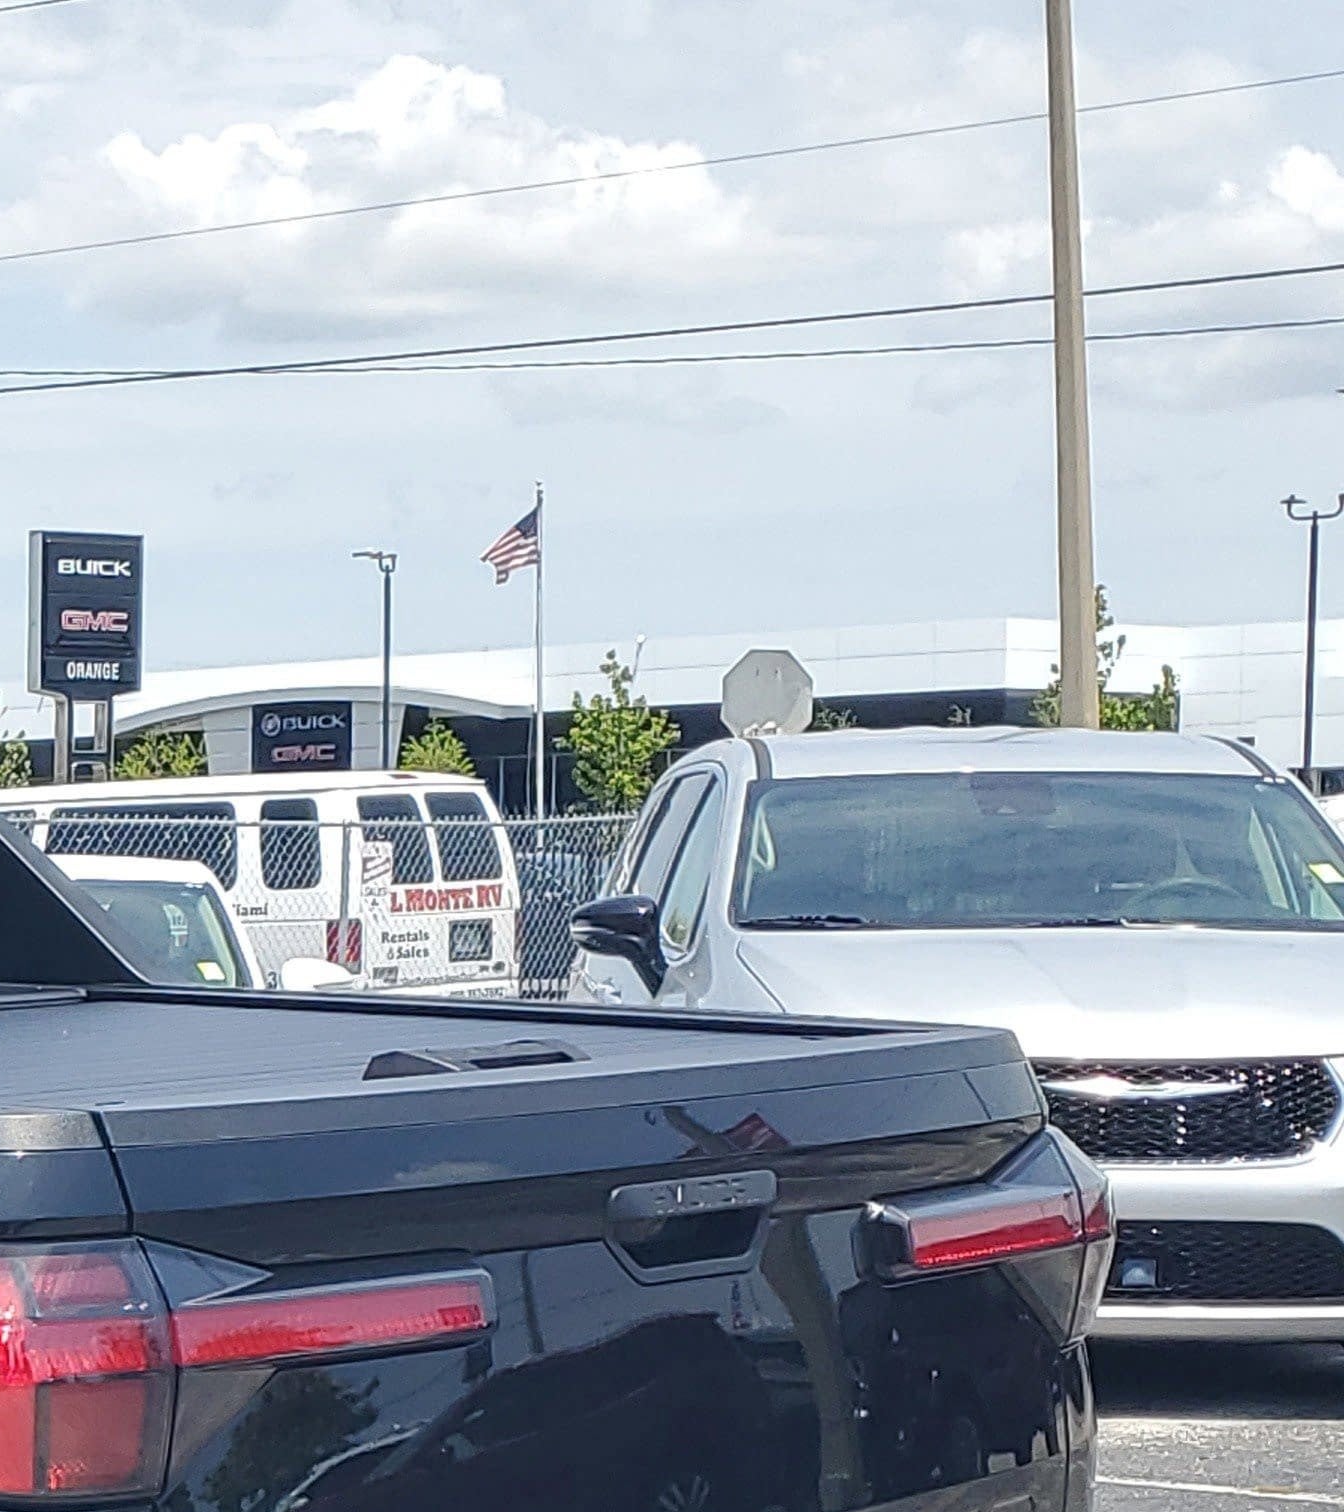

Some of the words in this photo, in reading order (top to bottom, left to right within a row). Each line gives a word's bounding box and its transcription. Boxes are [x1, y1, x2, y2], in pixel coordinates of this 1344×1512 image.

[57, 558, 132, 577] BUICK
[61, 609, 129, 632] GMC
[66, 660, 121, 681] ORANGE
[282, 712, 347, 731] BUICK
[272, 743, 336, 763] GMC
[403, 887, 474, 912] MONTE
[475, 884, 503, 908] RV
[232, 902, 269, 916] iami
[380, 929, 430, 944] Rentals
[395, 946, 430, 959] Sales
